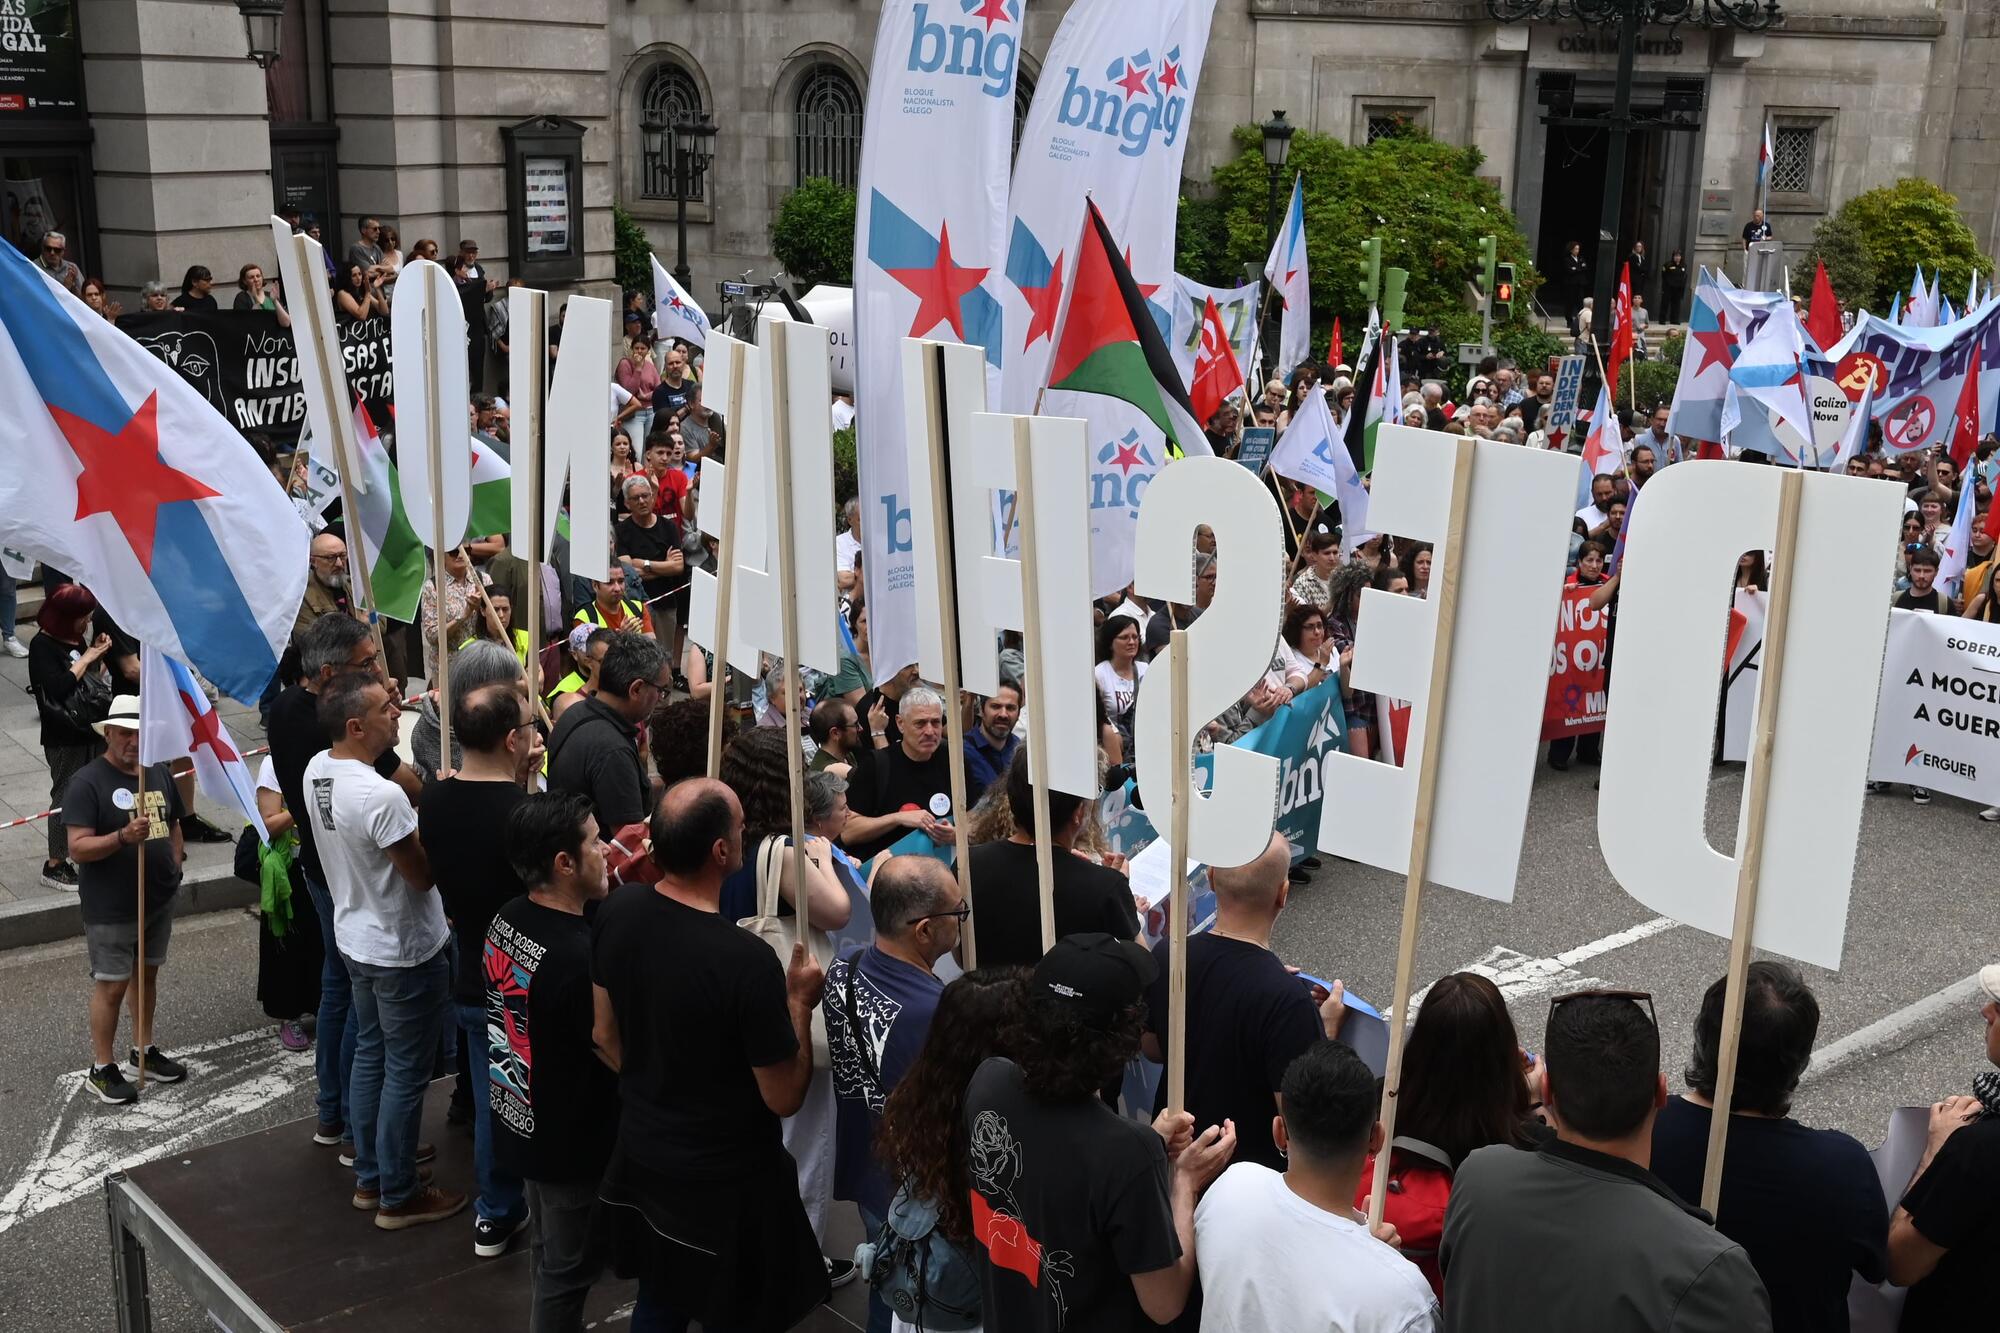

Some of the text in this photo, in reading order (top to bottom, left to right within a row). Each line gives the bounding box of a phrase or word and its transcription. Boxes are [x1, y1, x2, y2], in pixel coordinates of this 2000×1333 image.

[0, 16, 35, 33] IDA
[0, 32, 47, 52] GAL
[907, 3, 1016, 98] bng
[904, 88, 934, 97] BLOQUE
[902, 106, 932, 114] GALEGO
[903, 98, 954, 107] NACIONALISTA
[1057, 66, 1154, 158] bng
[1052, 136, 1076, 147] BLOQUE
[1048, 151, 1073, 162] GALEGO
[1049, 144, 1090, 158] NACIONALISTA
[1560, 359, 1583, 377] IN
[1558, 376, 1580, 391] DE
[1555, 389, 1577, 402] PEN
[1813, 395, 1847, 409] Galiza
[1553, 399, 1574, 413] DEN
[1551, 411, 1571, 427] CIA
[1812, 410, 1839, 422] Nova
[1090, 470, 1157, 519] ng
[1906, 668, 2000, 704] A MOCI
[1913, 702, 1931, 722] A
[1923, 753, 1976, 780] ERGUER
[1278, 750, 1328, 818] bn
[513, 931, 547, 960] NOBRE
[489, 1096, 535, 1133] ROGRESO
